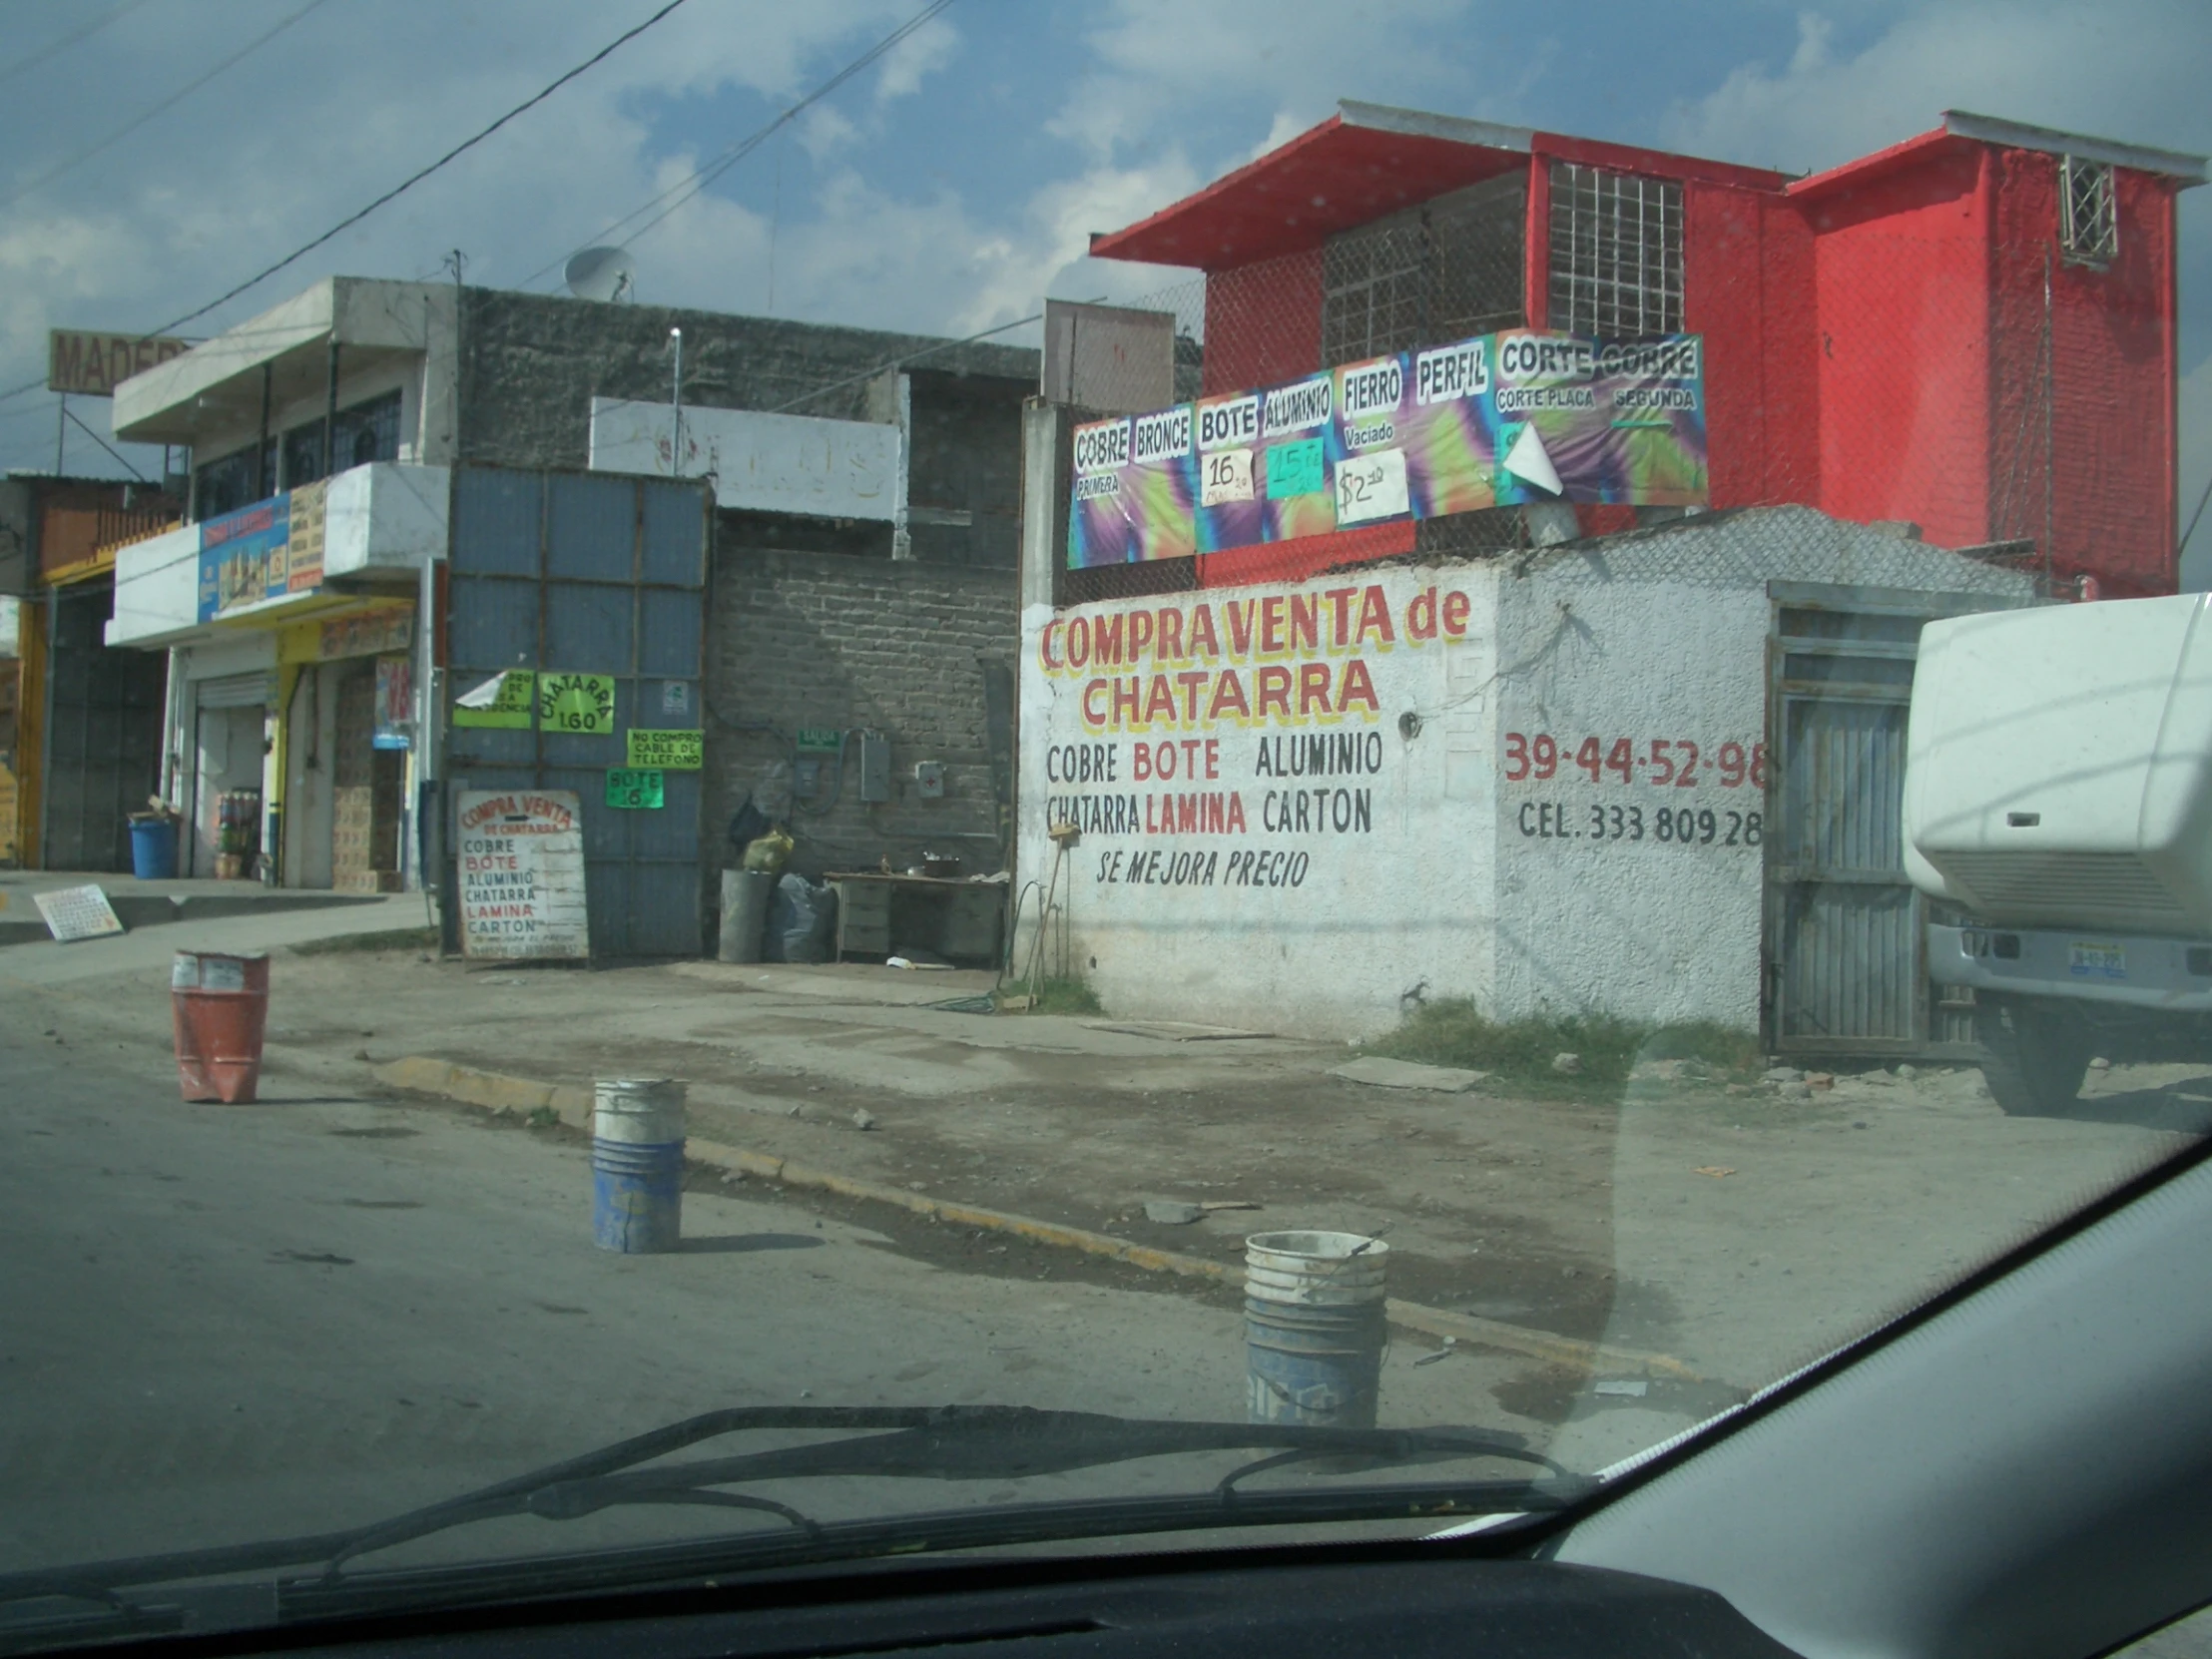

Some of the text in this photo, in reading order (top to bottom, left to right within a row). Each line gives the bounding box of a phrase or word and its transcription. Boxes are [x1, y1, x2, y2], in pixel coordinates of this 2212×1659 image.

[1077, 340, 1696, 468] COBRE BRONCE BOTE ALUMINIO FIERRO PERFIL CORTE COBRE
[1498, 388, 1594, 407] CORTE PLACA
[1616, 389, 1695, 408] SEGUNDA
[1347, 423, 1393, 446] Vaciado
[1209, 456, 1234, 487] 16
[1403, 585, 1471, 647] de
[541, 676, 612, 720] CHATARRA
[1080, 659, 1381, 737] CHATARRA
[633, 733, 703, 743] NO COMPRO
[635, 744, 696, 754] CABLE DE
[1047, 732, 1382, 783] COBRE BOTE ALUMINIO
[635, 755, 701, 765] TELEFONO
[461, 796, 573, 830] COMPRA VENTA
[1047, 789, 1371, 834] CHATARRA LAMINA CARTON
[1518, 803, 1581, 838] CEL.
[464, 839, 516, 853] COBRE
[466, 855, 518, 870] BOTE
[1097, 850, 1310, 887] SE MEJORA PRECIO
[467, 871, 534, 886] ALUMINIO
[465, 888, 537, 902] CHATARRA
[466, 903, 534, 918] LAMINA
[468, 919, 537, 934] CARTON
